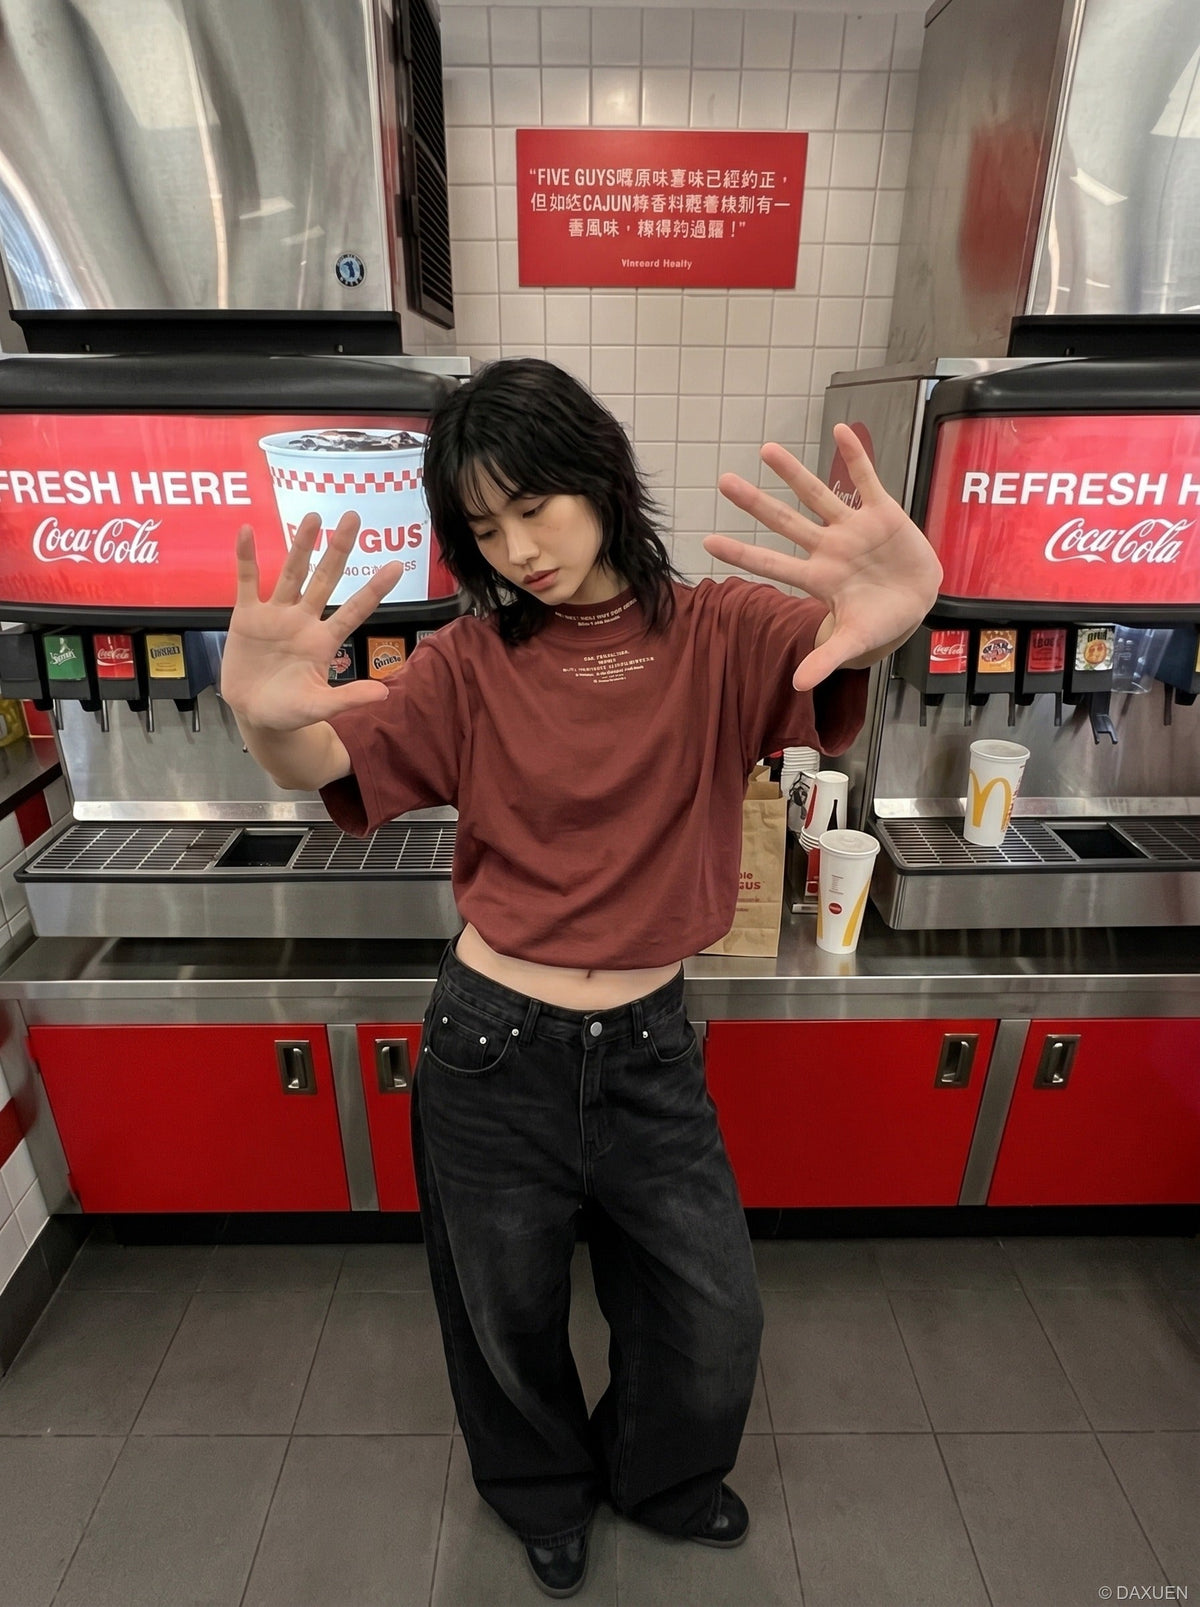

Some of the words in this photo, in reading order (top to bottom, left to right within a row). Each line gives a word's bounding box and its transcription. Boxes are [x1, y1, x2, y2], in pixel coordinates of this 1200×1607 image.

[131, 471, 252, 505] HERE
[961, 472, 1168, 506] REFRESH
[32, 516, 162, 565] Coca-Cola
[358, 522, 423, 554] GUS
[1044, 518, 1197, 564] Coca-Cola
